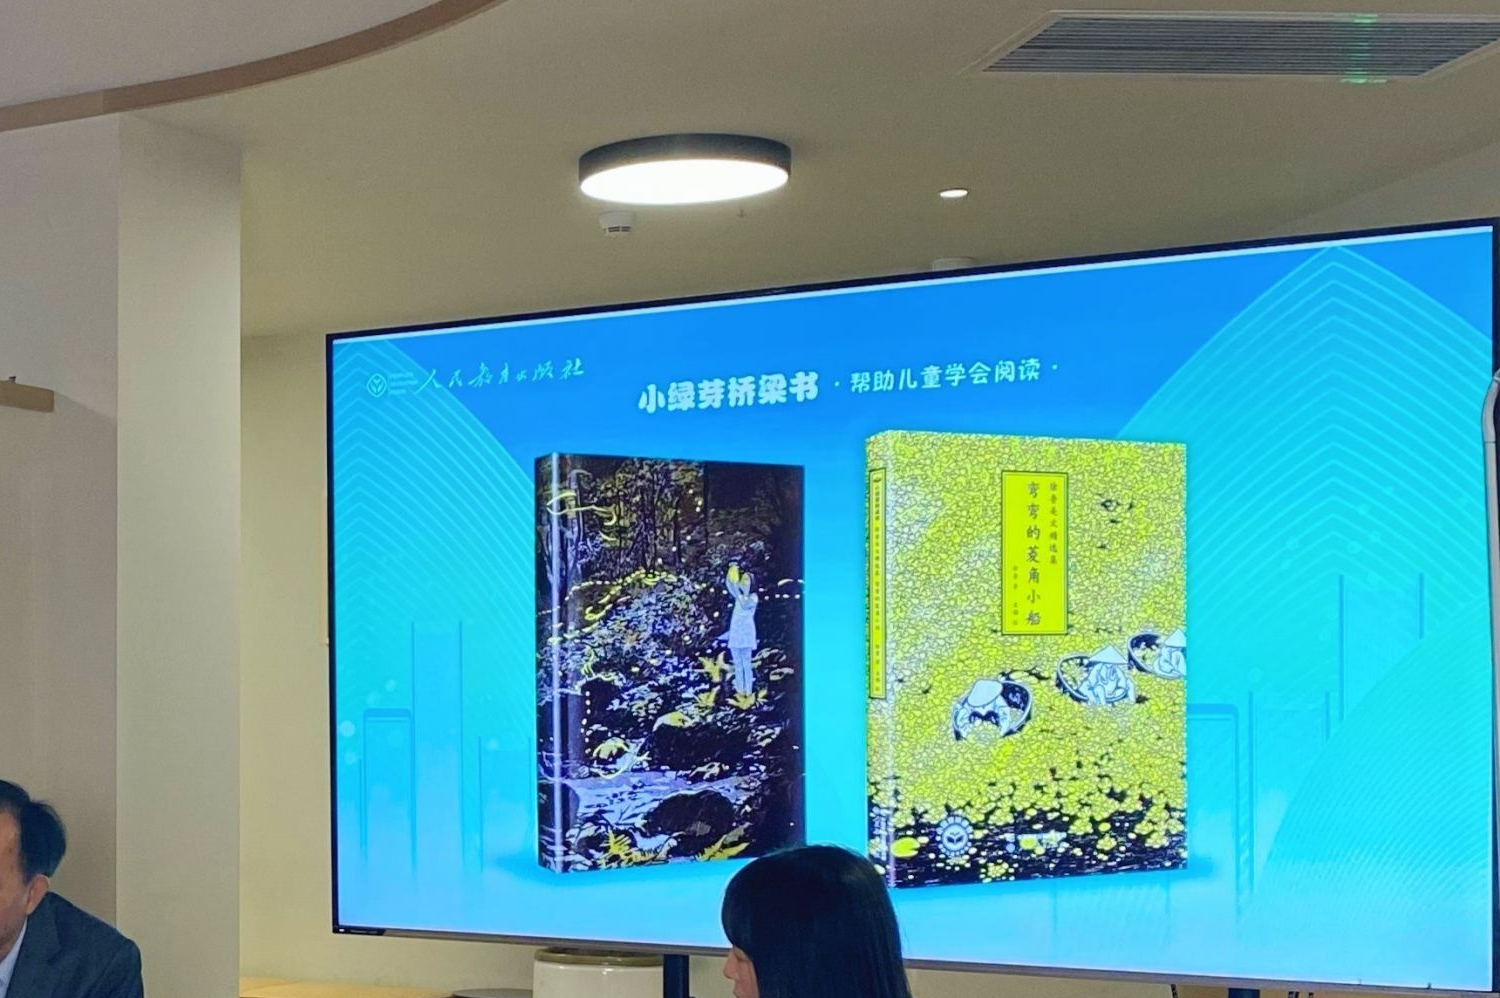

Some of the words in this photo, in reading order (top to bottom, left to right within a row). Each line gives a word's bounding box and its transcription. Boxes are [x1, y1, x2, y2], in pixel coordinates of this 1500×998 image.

[637, 371, 819, 414] 小绿芽桥梁书
[1026, 481, 1041, 626] 弯弯的菱角小船
